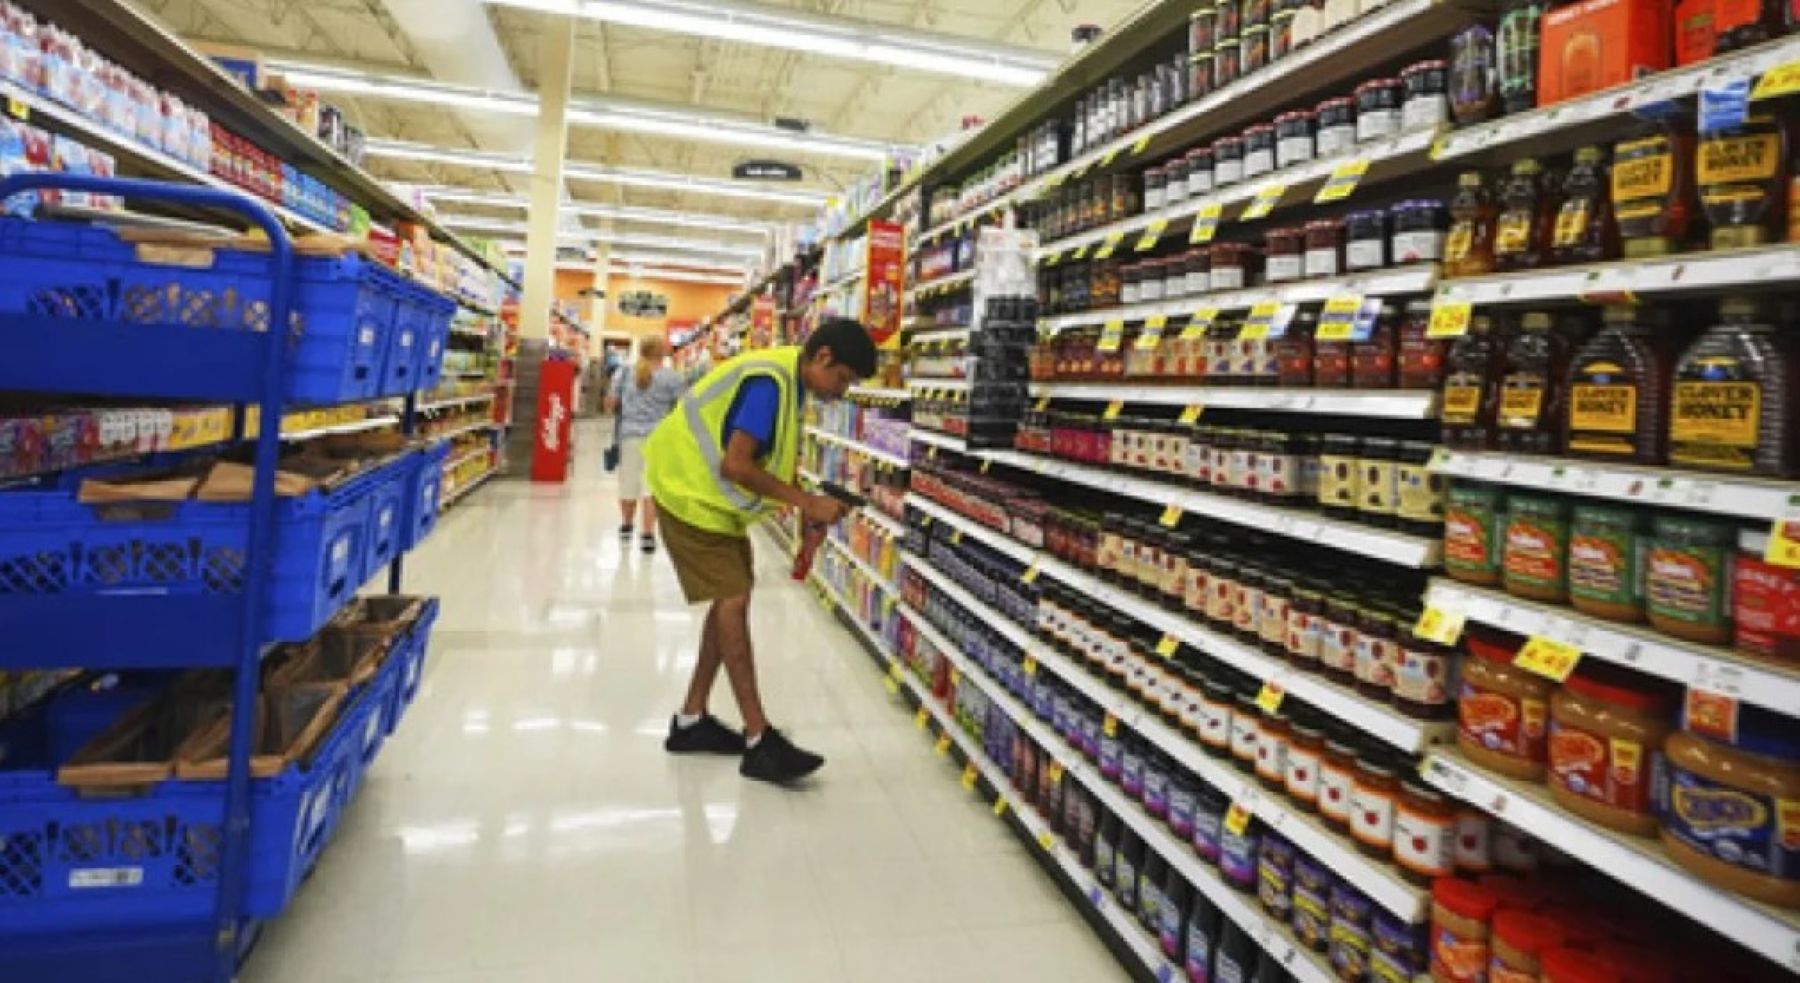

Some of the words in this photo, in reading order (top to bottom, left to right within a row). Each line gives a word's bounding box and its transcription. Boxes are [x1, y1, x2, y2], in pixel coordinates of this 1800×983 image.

[1679, 385, 1755, 400] CLOVER
[1577, 400, 1626, 415] HONEY
[1680, 403, 1752, 420] HONEY
